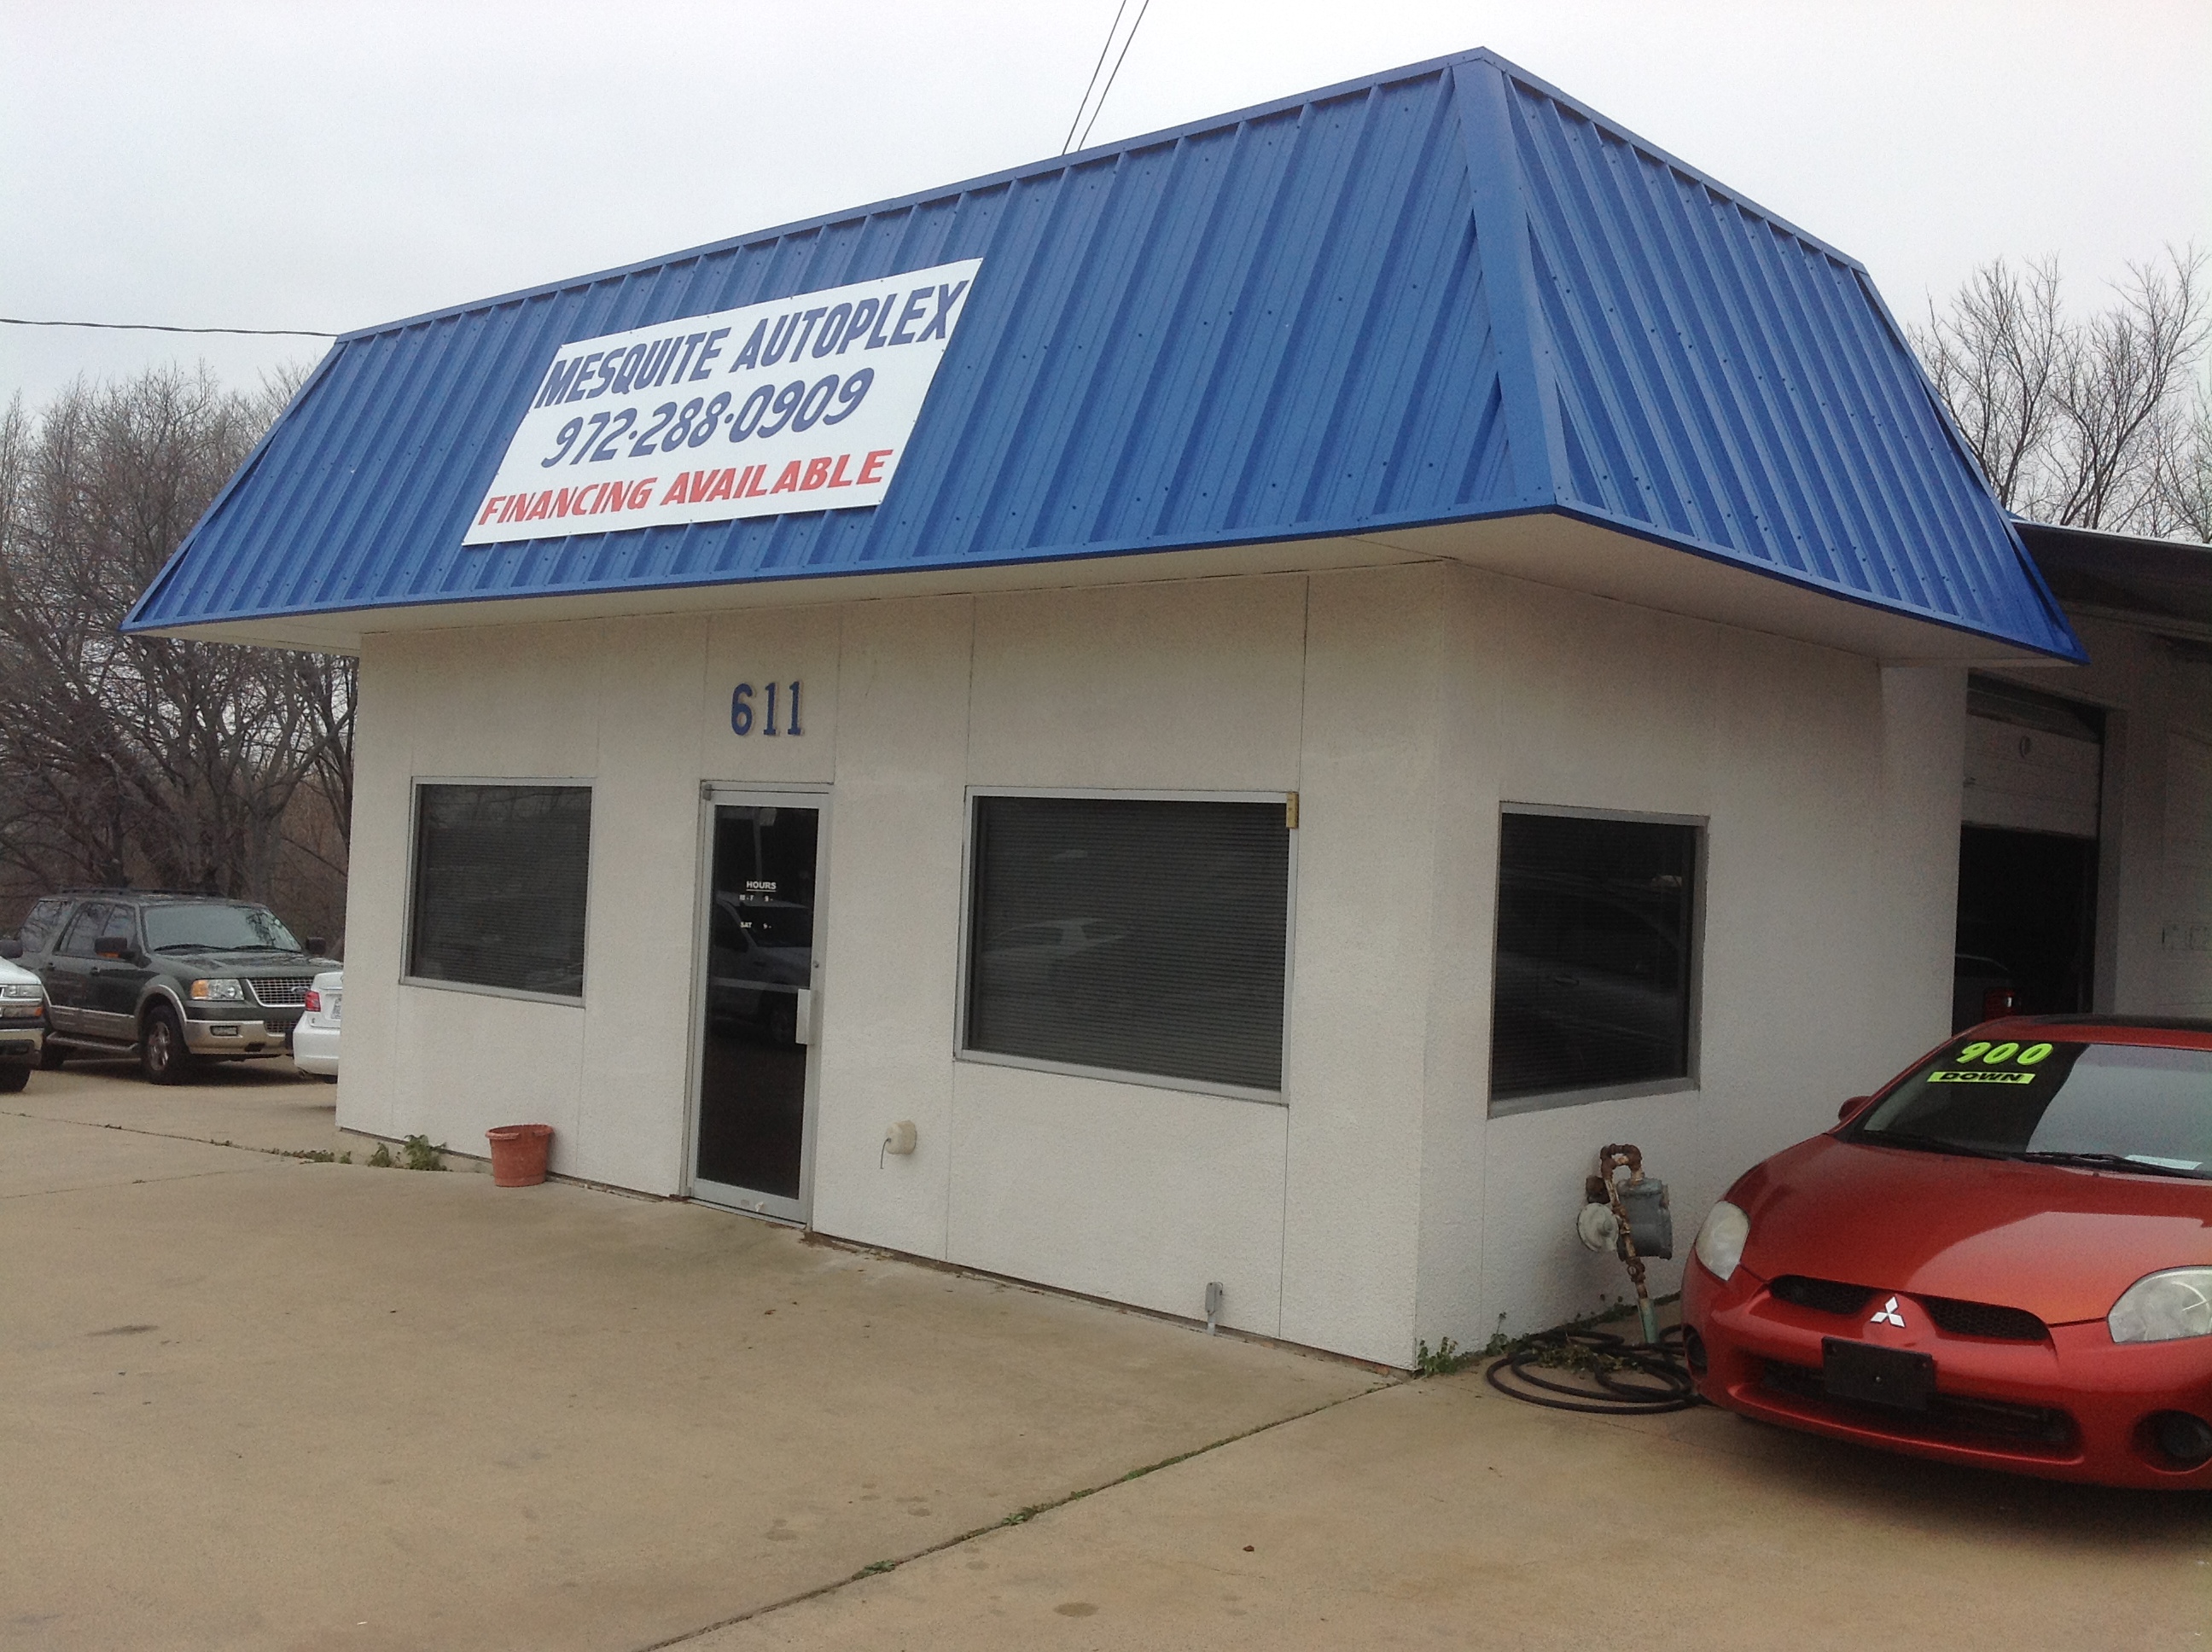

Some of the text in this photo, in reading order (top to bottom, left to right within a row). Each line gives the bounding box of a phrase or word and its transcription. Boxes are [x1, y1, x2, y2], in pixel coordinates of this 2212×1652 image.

[533, 280, 969, 409] MESQUITE AUTOPLEX
[478, 450, 894, 526] FINANCING AVAILABLE
[731, 681, 801, 736] 611
[746, 881, 777, 889] HOURS
[1956, 1042, 2053, 1066] 900
[1939, 1073, 2024, 1081] DOWN
